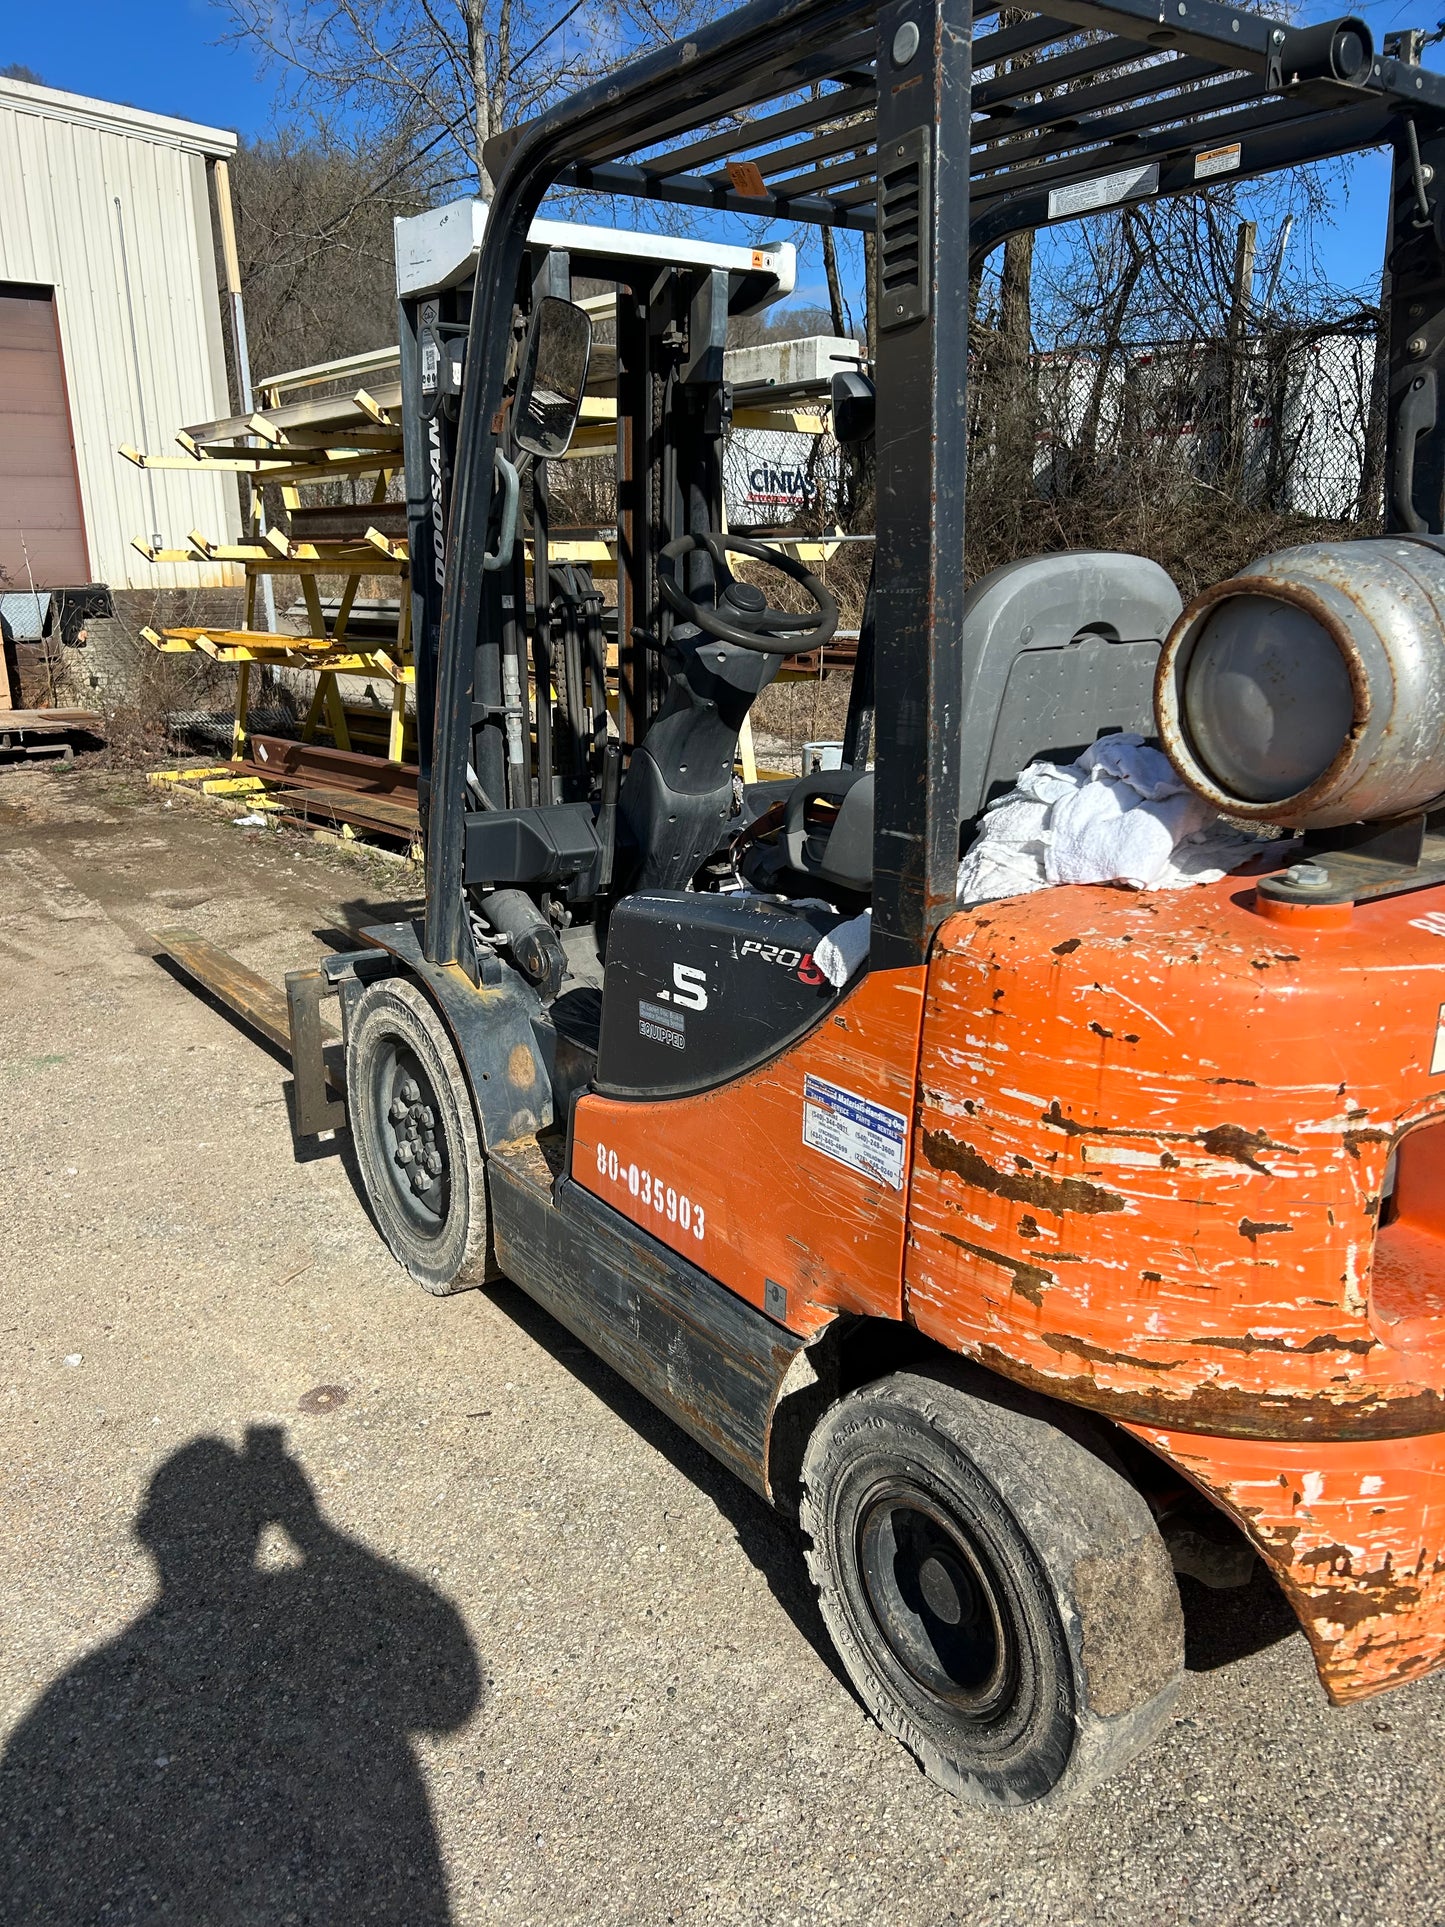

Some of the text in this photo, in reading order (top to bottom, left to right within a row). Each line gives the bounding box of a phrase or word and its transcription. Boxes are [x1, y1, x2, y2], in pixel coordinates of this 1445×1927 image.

[428, 416, 446, 588] DOOSAN
[639, 1020, 686, 1049] EQUIPPED
[597, 1142, 705, 1241] 80-035903
[952, 1454, 1012, 1531] MITCHELL
